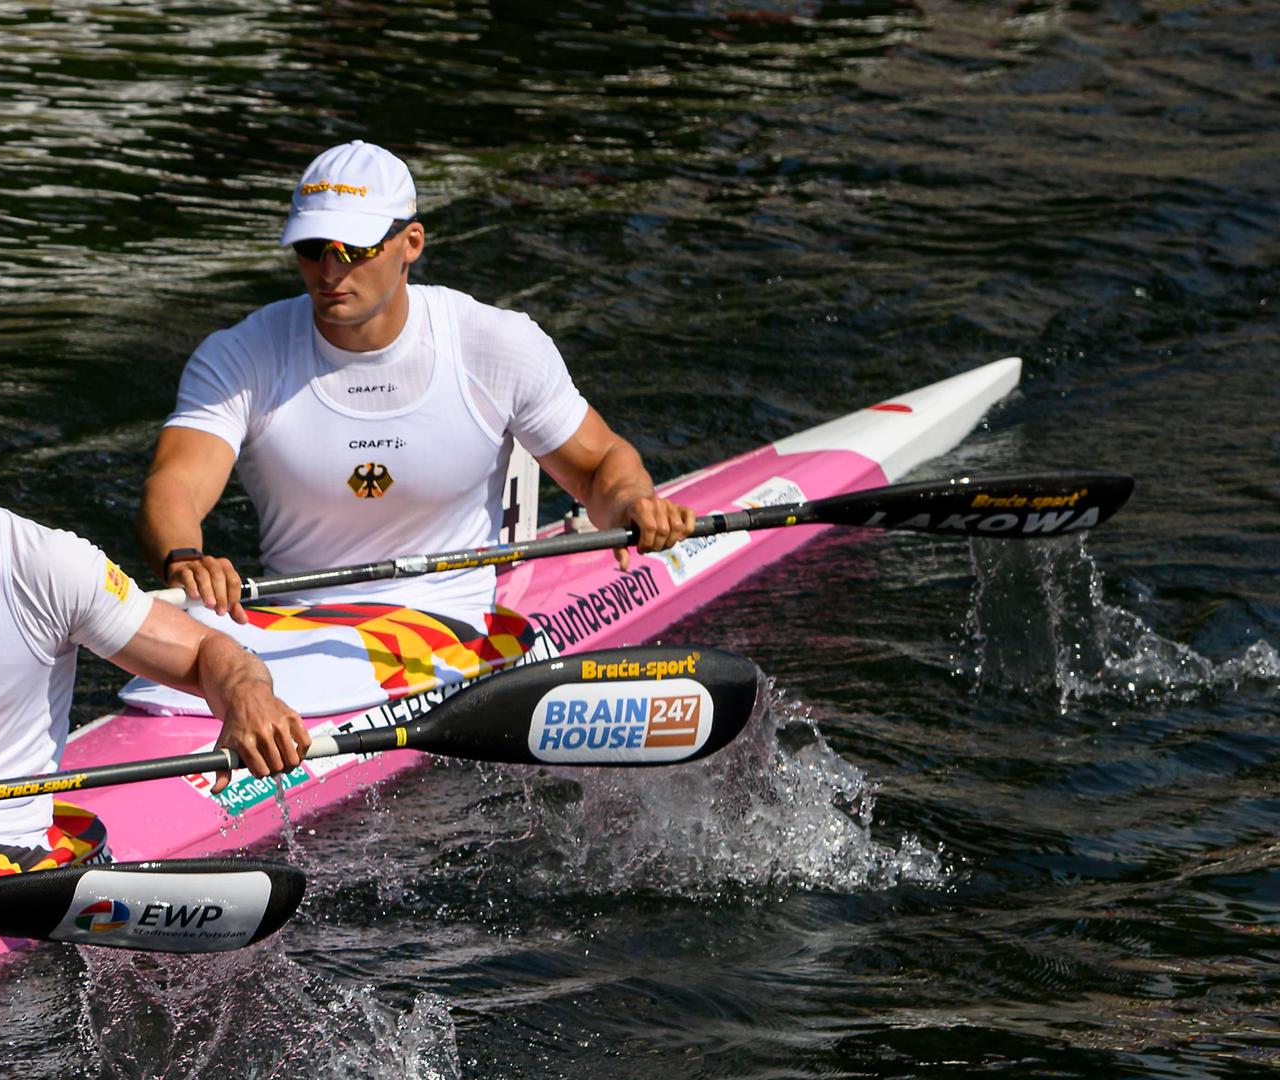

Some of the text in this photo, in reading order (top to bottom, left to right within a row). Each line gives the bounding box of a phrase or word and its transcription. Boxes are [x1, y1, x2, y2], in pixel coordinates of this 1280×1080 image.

[347, 385, 385, 394] CRAFT
[348, 439, 393, 449] CRAFT
[544, 697, 699, 726] BRAIN 247
[538, 725, 645, 750] HOUSE
[136, 904, 223, 929] EWP
